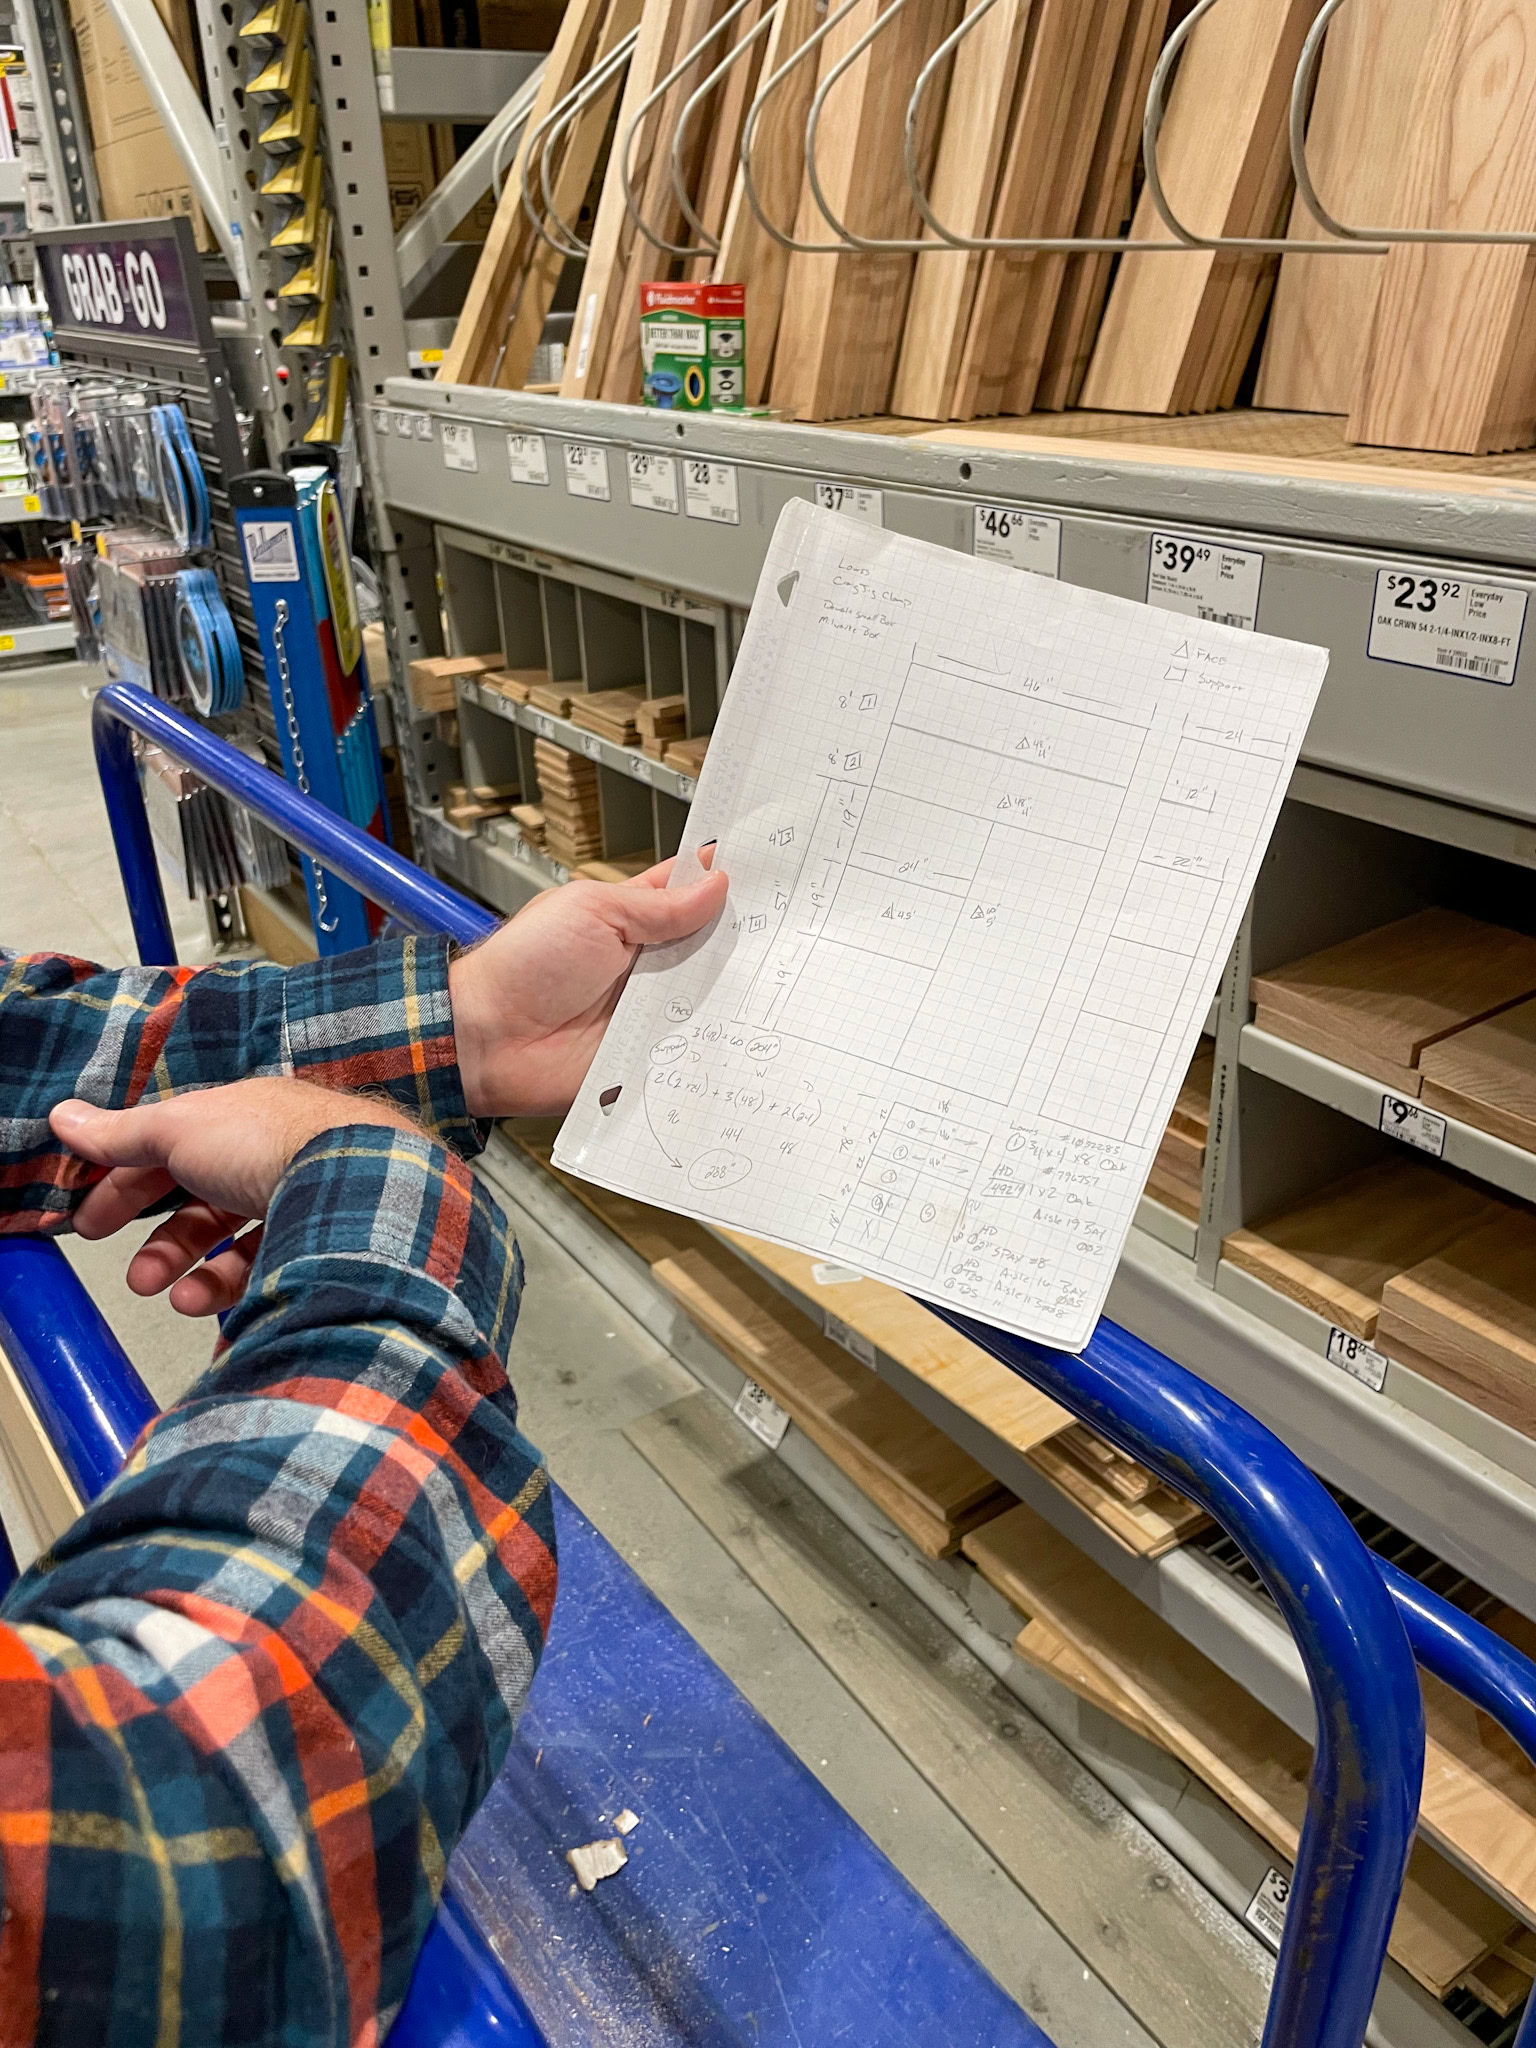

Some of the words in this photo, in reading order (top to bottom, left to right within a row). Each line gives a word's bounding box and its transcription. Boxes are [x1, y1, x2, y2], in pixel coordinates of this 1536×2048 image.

[62, 253, 124, 324] GRAB
[124, 250, 167, 330] GO
[1222, 555, 1246, 566] Everyday
[1471, 589, 1504, 603] Everyday
[1470, 600, 1484, 608] Low
[1468, 608, 1487, 619] Price
[1377, 615, 1392, 626] OAK
[1394, 617, 1417, 630] CRWN
